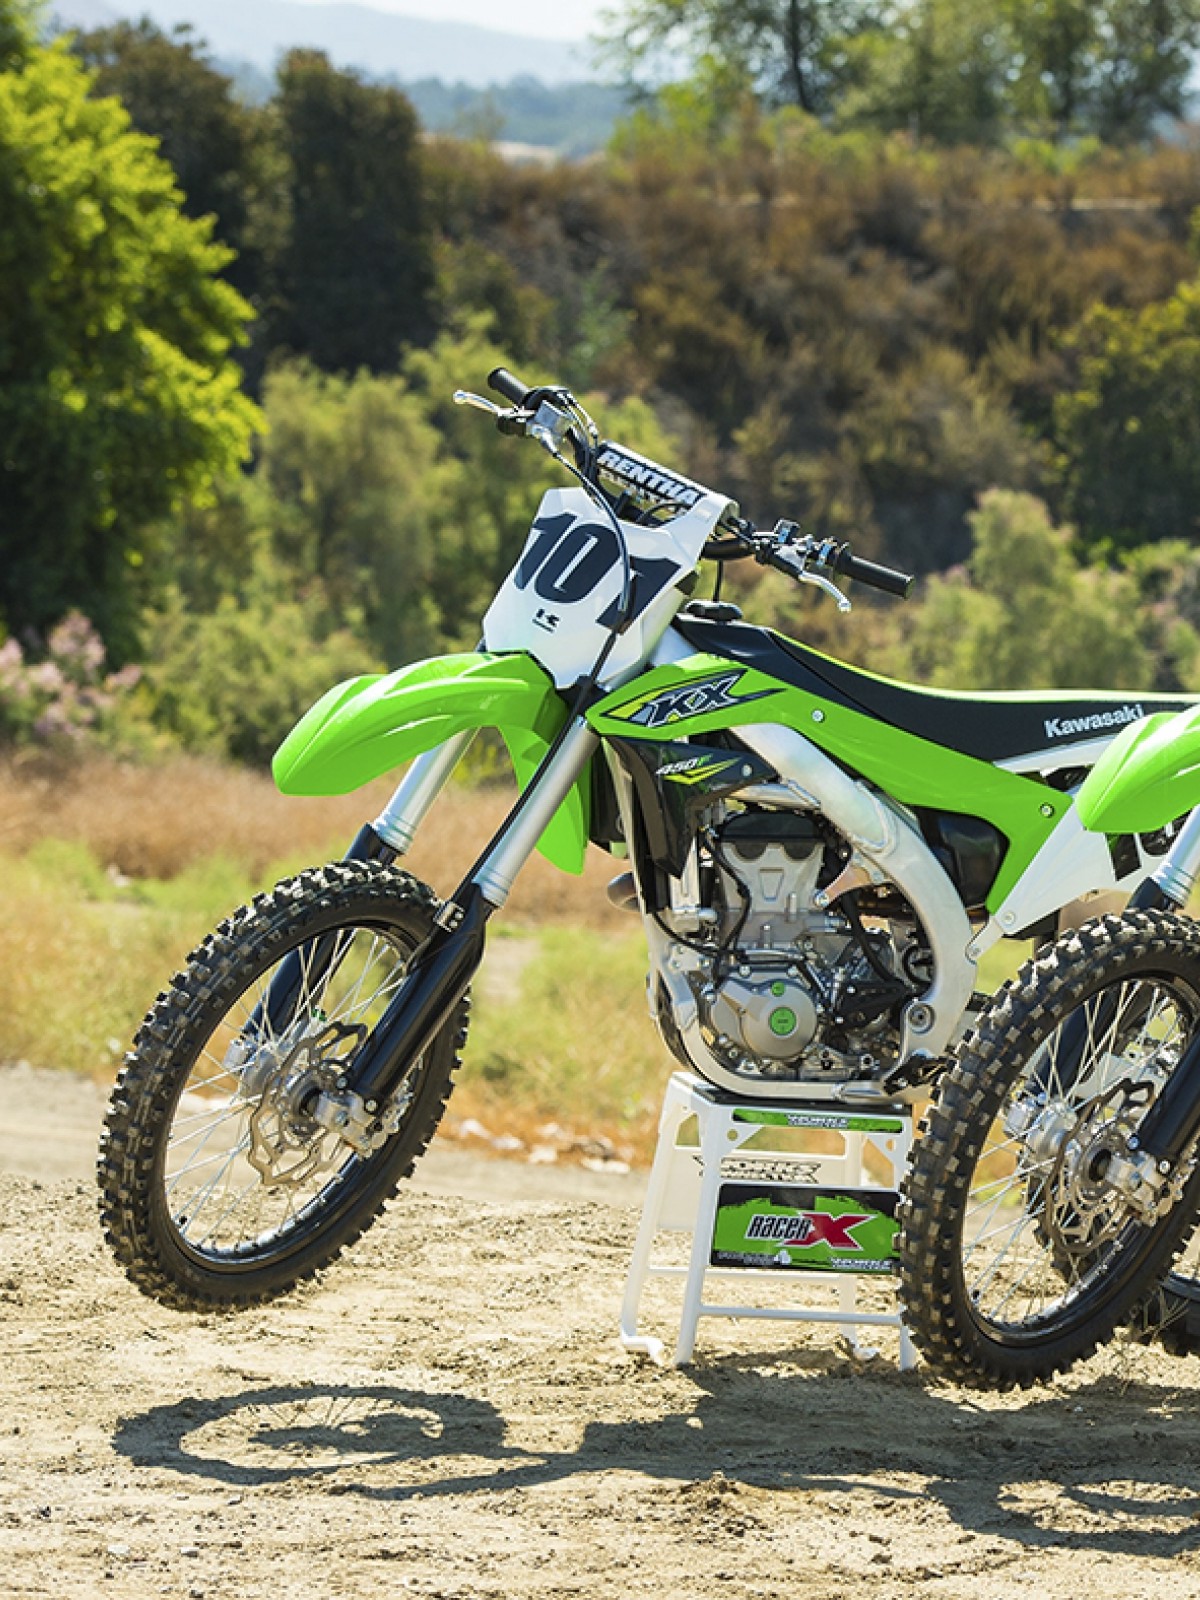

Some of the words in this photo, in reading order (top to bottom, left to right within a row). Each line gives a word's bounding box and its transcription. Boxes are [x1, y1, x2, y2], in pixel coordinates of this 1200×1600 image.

[597, 450, 701, 506] RENTHA
[647, 674, 741, 727] KX
[1043, 703, 1145, 738] Kawasaki
[779, 1212, 876, 1250] X
